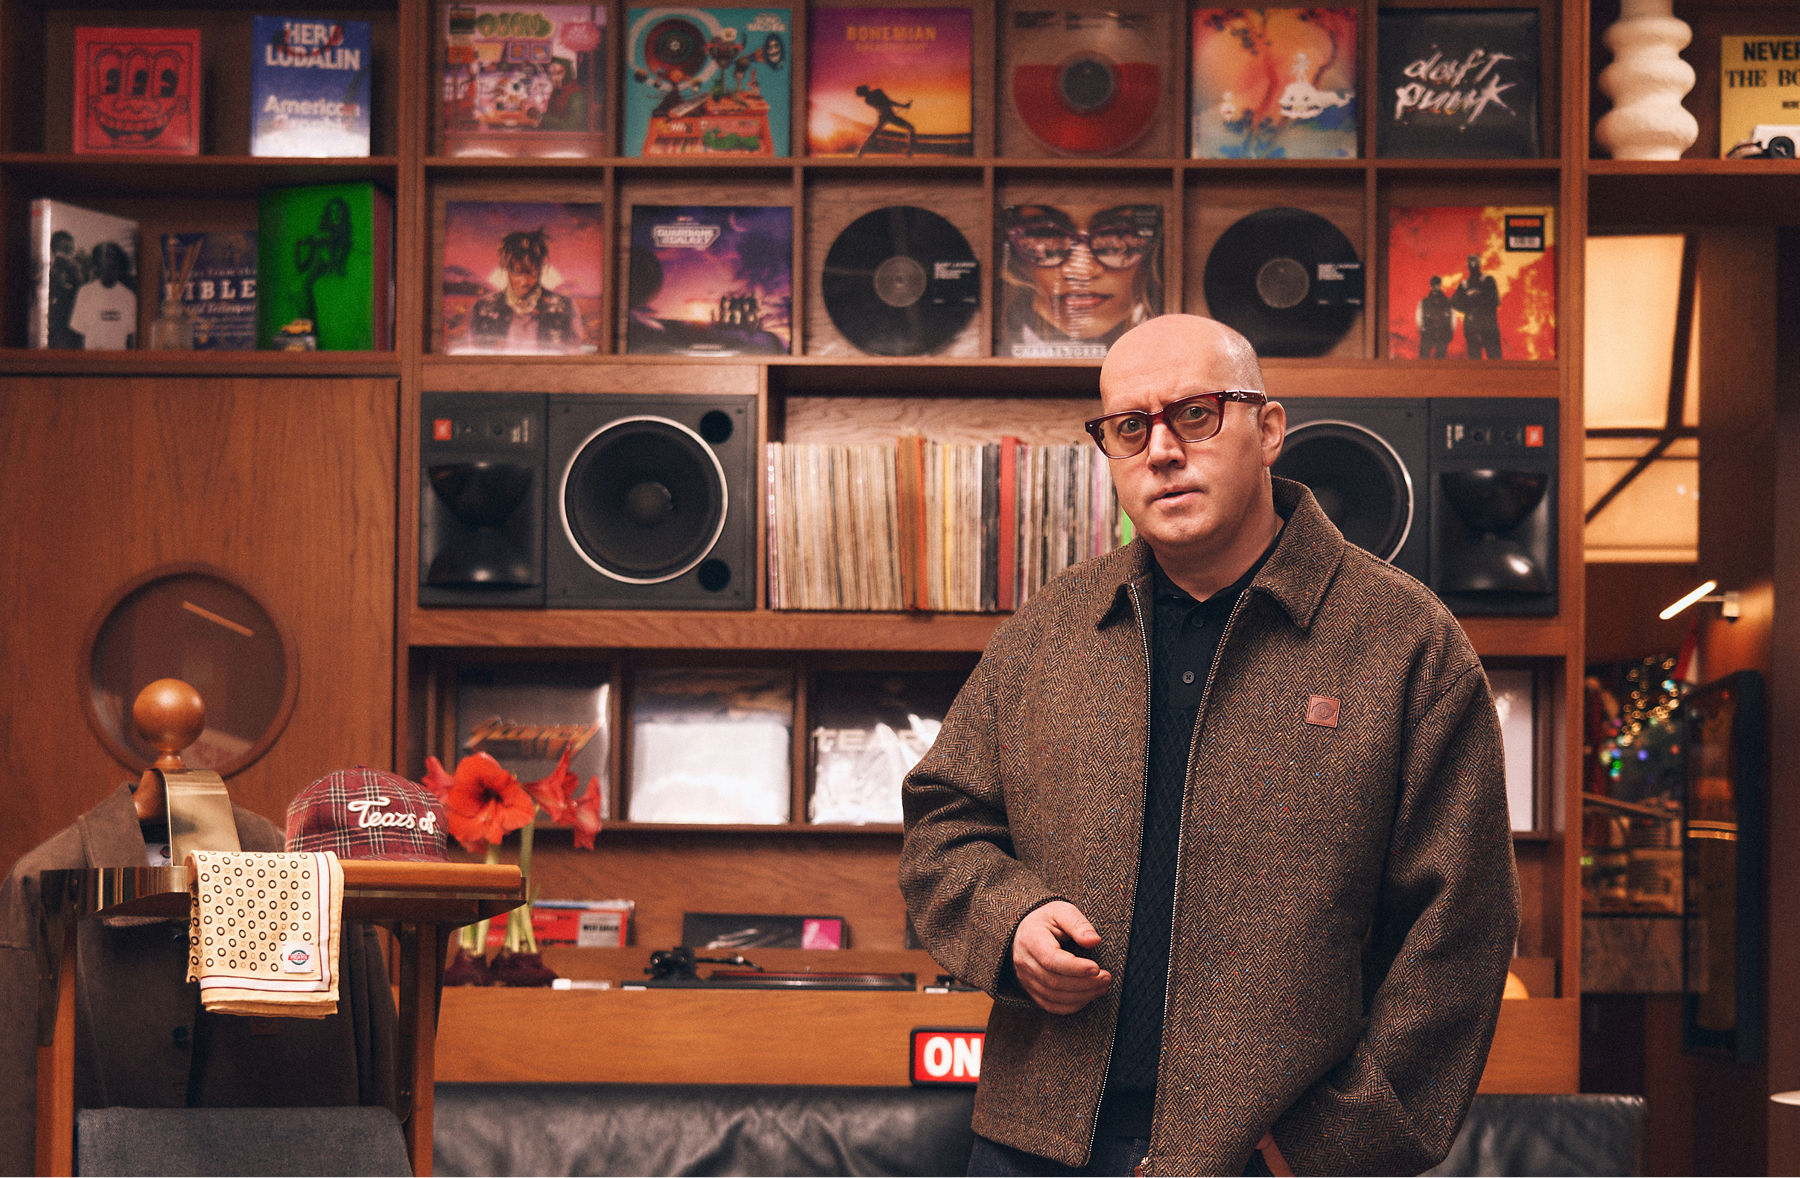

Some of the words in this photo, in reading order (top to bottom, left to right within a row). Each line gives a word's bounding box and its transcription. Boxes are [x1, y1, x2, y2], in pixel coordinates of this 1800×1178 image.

[846, 26, 937, 41] BOHEMIAN
[1402, 48, 1516, 89] daft
[1725, 69, 1767, 88] THE
[1394, 73, 1518, 123] punk
[923, 1036, 982, 1078] ON
